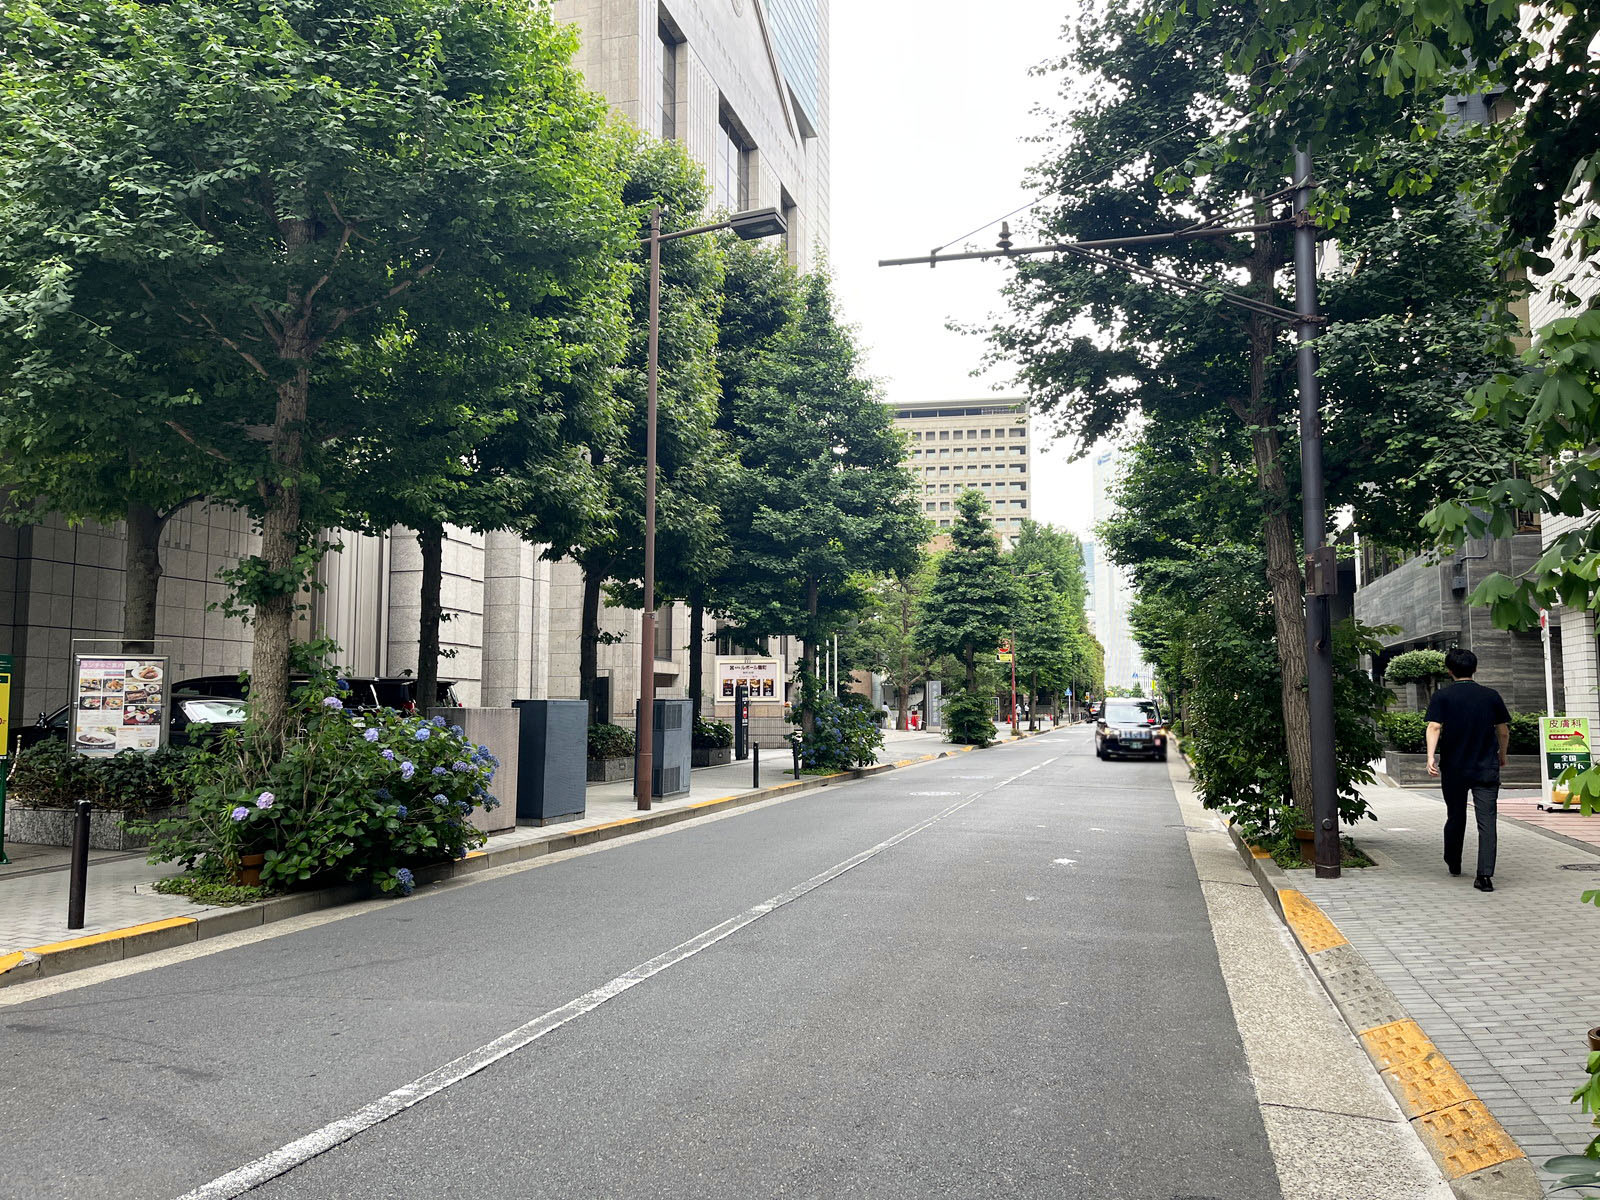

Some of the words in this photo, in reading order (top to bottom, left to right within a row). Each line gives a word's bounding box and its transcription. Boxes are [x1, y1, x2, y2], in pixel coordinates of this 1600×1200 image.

[1550, 719, 1581, 728] 皮膚科
[1561, 754, 1577, 762] 全国
